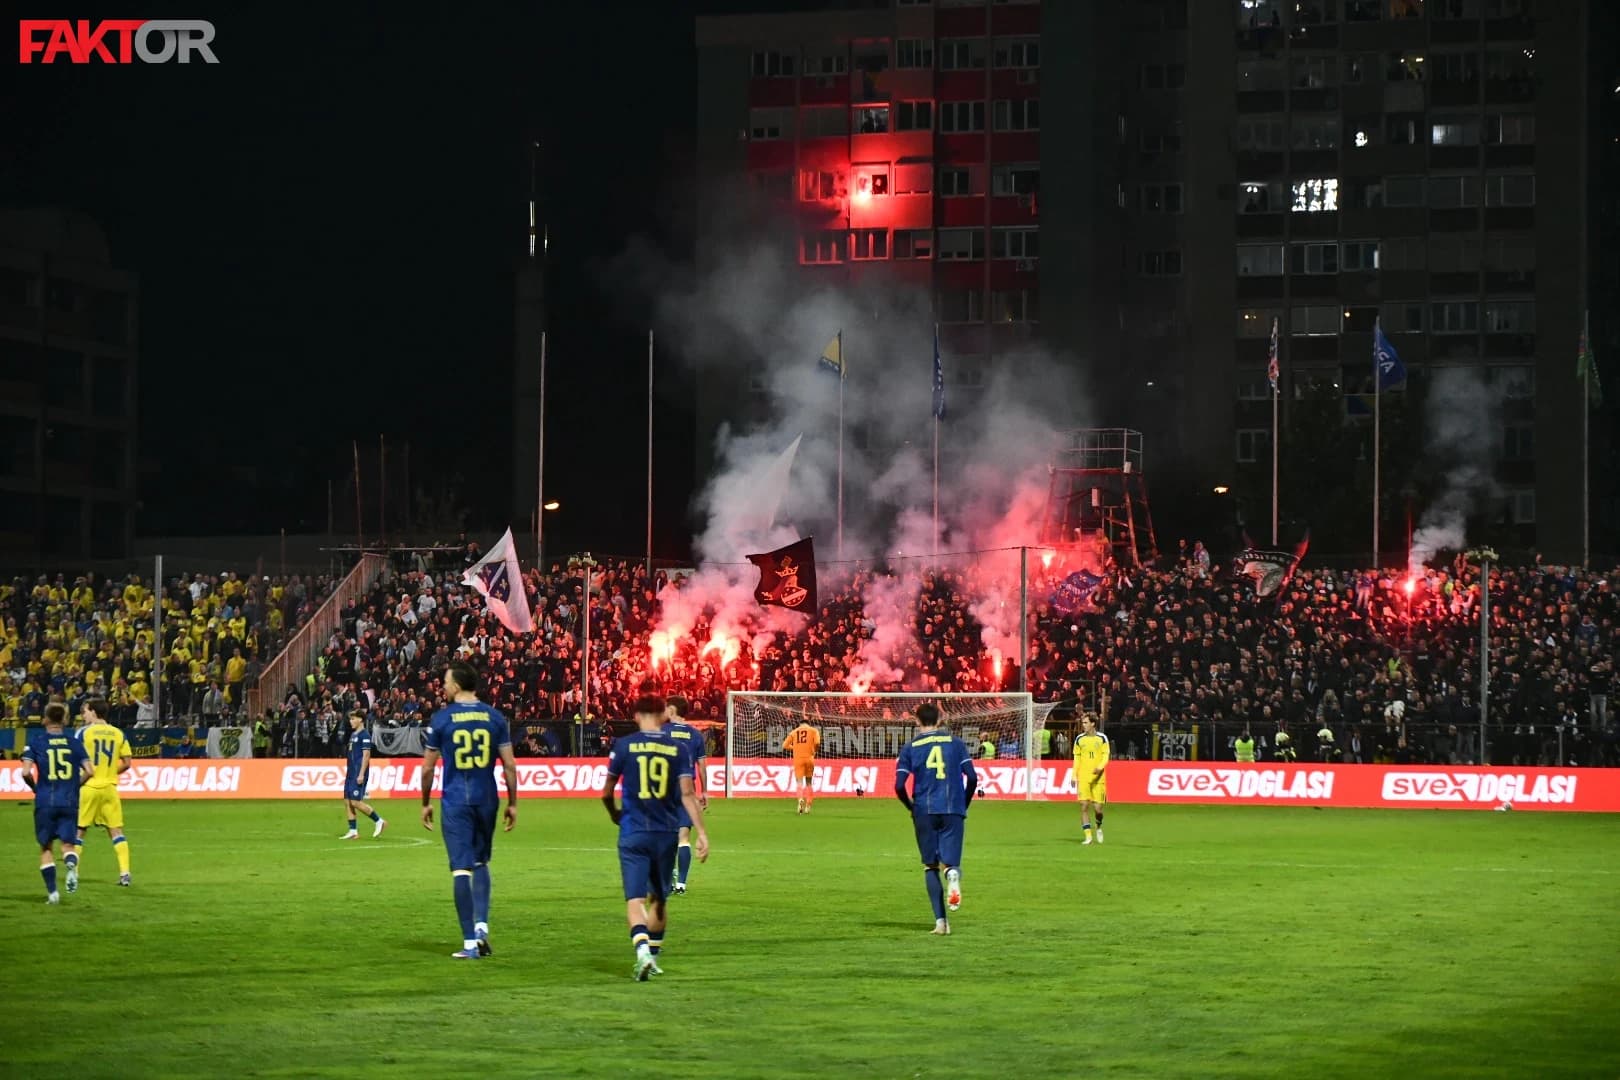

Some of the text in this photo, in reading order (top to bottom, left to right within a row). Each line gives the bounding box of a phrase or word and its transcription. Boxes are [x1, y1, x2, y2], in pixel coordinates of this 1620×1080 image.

[453, 728, 490, 769] 23
[795, 730, 808, 744] 12
[46, 748, 73, 780] 15
[94, 739, 115, 767] 14
[926, 745, 946, 780] 4
[159, 766, 240, 792] OGLASI
[636, 755, 669, 800] 19
[1239, 769, 1335, 799] OGLASI
[1477, 774, 1577, 803] OGLASI
